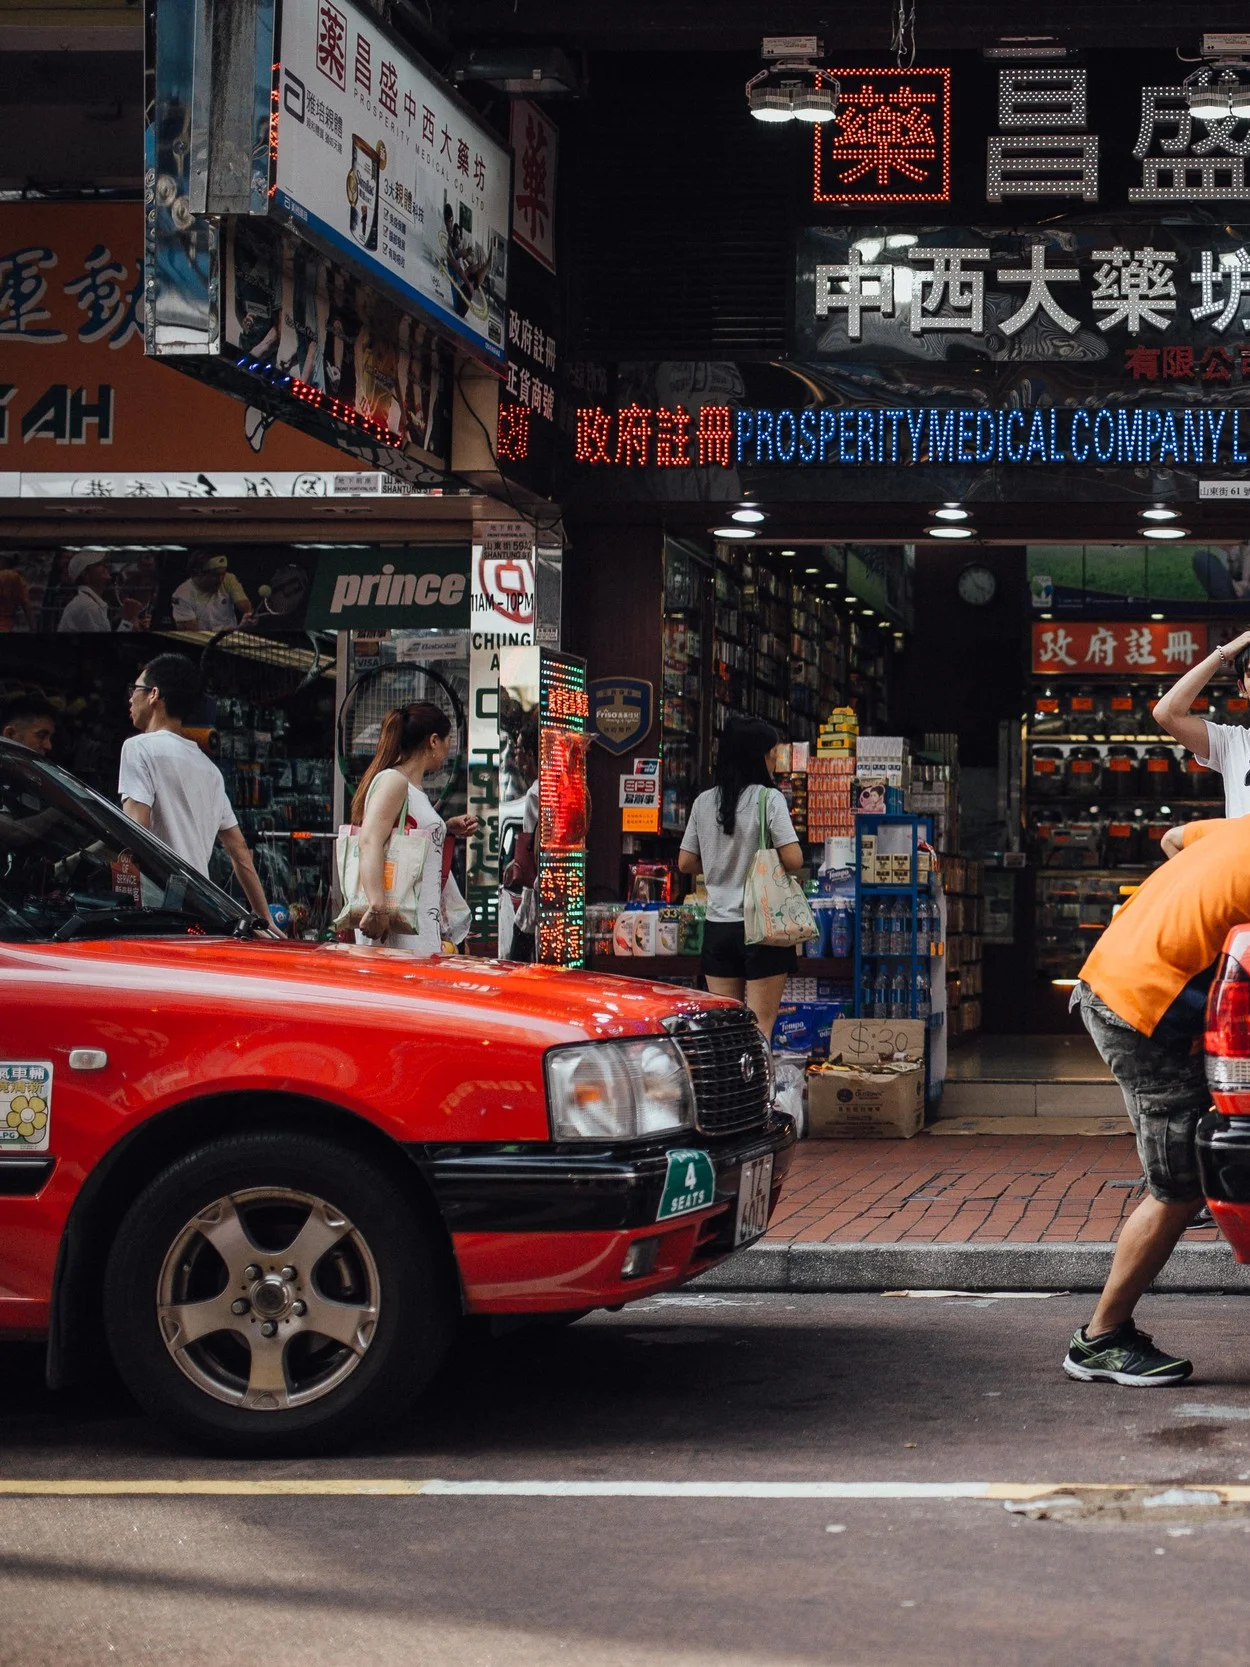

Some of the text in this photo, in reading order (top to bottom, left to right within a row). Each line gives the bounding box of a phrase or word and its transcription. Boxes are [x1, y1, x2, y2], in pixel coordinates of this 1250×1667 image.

[354, 88, 410, 148] PROSPERITY
[415, 144, 450, 182] MEDICAL
[574, 403, 733, 468] 政府註冊
[1231, 486, 1241, 496] 61
[330, 563, 467, 614] prince
[471, 593, 495, 613] 11AM
[506, 592, 534, 613] 10PM
[472, 632, 532, 651] CHUNG
[1039, 626, 1200, 667] 政府註冊
[357, 656, 379, 667] VISA
[625, 780, 656, 792] EPS
[116, 874, 137, 885] SERVICE
[779, 1021, 806, 1033] Tempo
[684, 1161, 697, 1190] 4
[670, 1189, 706, 1213] SEATS
